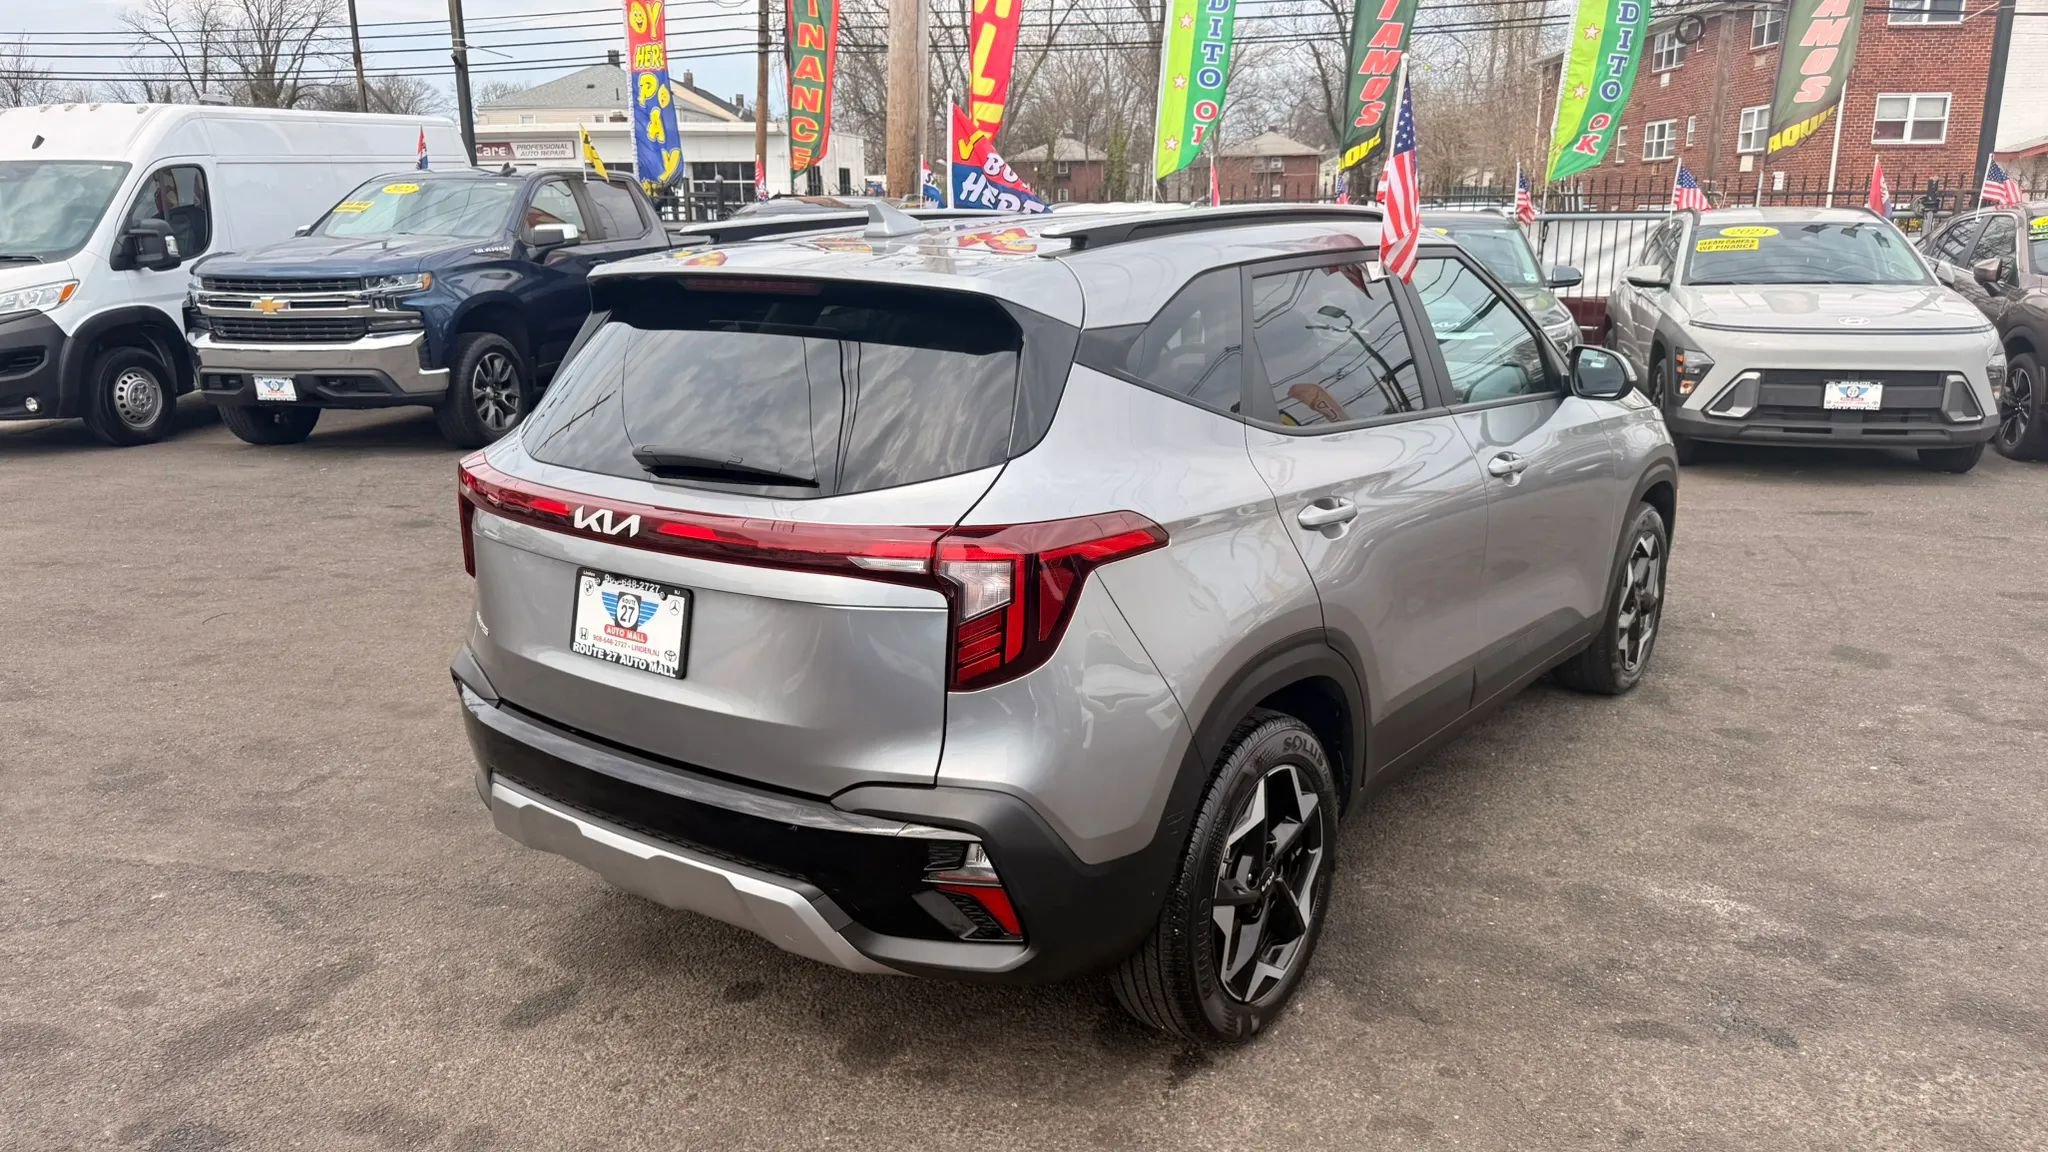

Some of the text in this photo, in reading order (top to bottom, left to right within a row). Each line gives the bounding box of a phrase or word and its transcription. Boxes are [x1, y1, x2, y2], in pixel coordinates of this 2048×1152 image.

[516, 143, 569, 151] PROFESSIONAL
[1573, 113, 1613, 155] OK
[574, 505, 641, 538] KIA
[620, 604, 636, 624] 27
[606, 626, 646, 643] AUTO MALL
[572, 642, 677, 678] ROUTE 27 AUTO MALL
[1282, 735, 1324, 768] SOLUS
